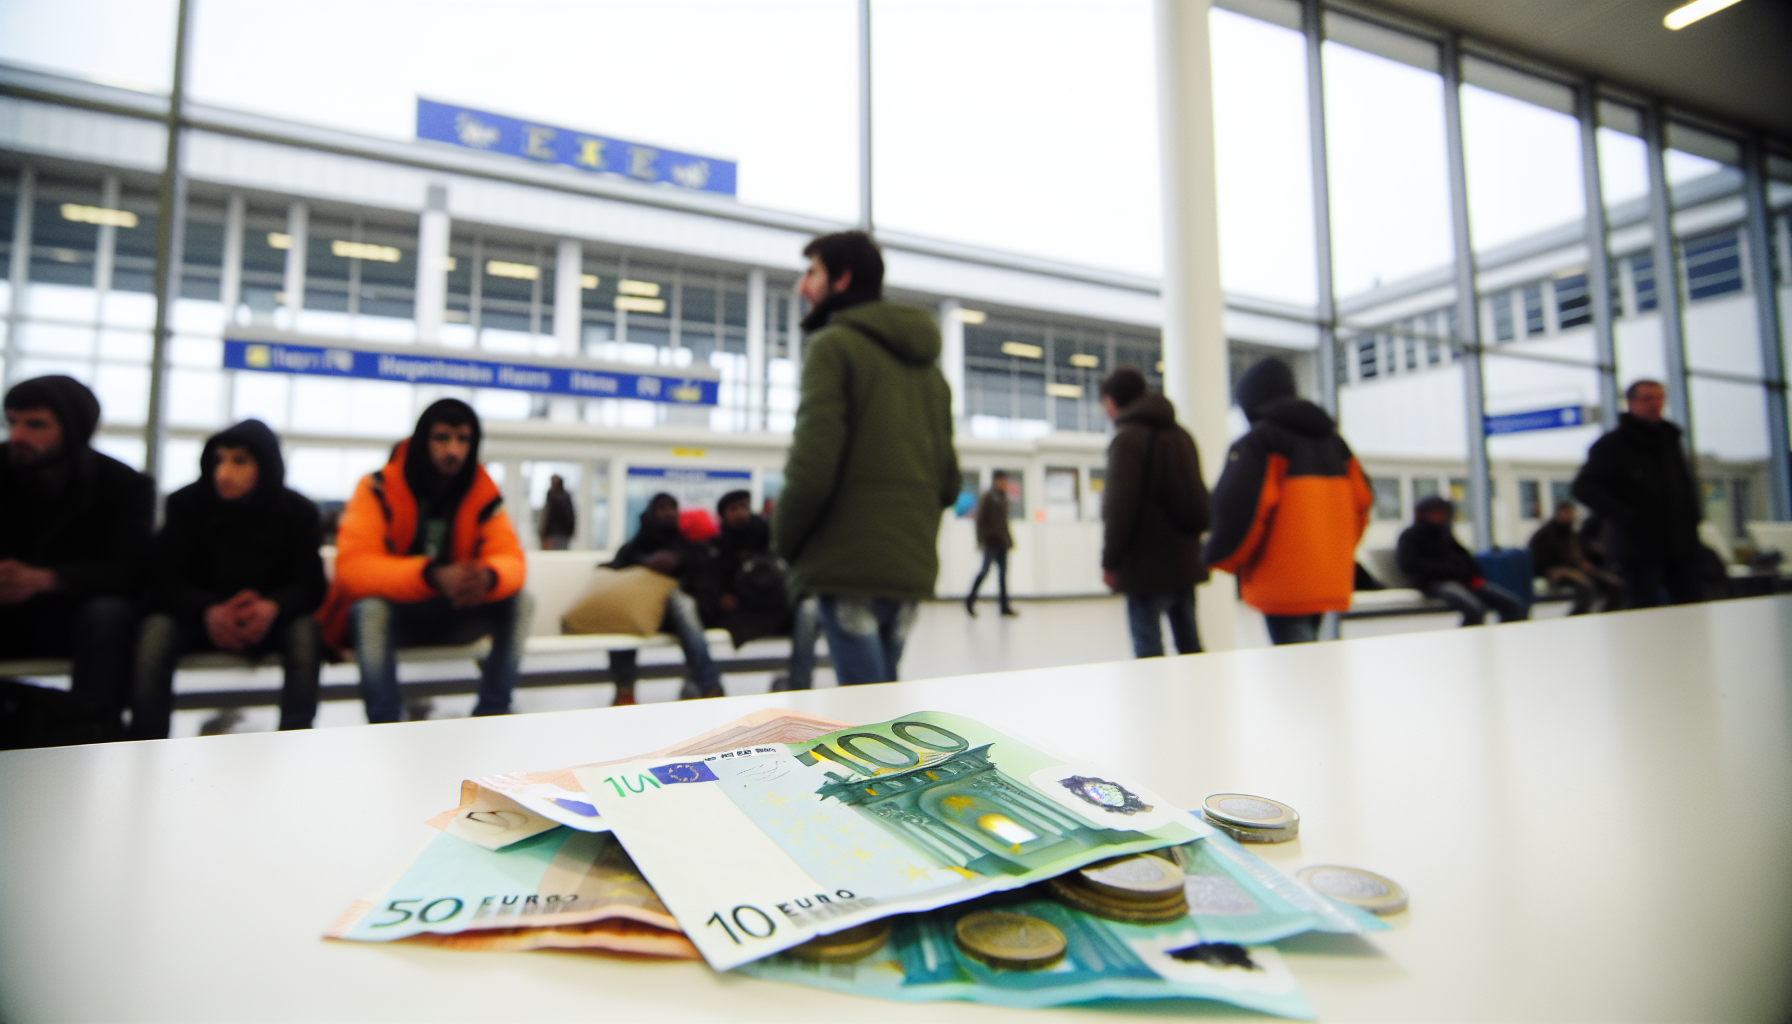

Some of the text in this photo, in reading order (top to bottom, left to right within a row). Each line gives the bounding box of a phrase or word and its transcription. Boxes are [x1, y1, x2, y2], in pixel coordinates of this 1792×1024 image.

[794, 721, 970, 777] 100
[370, 897, 464, 928] 50
[706, 904, 776, 945] 10
